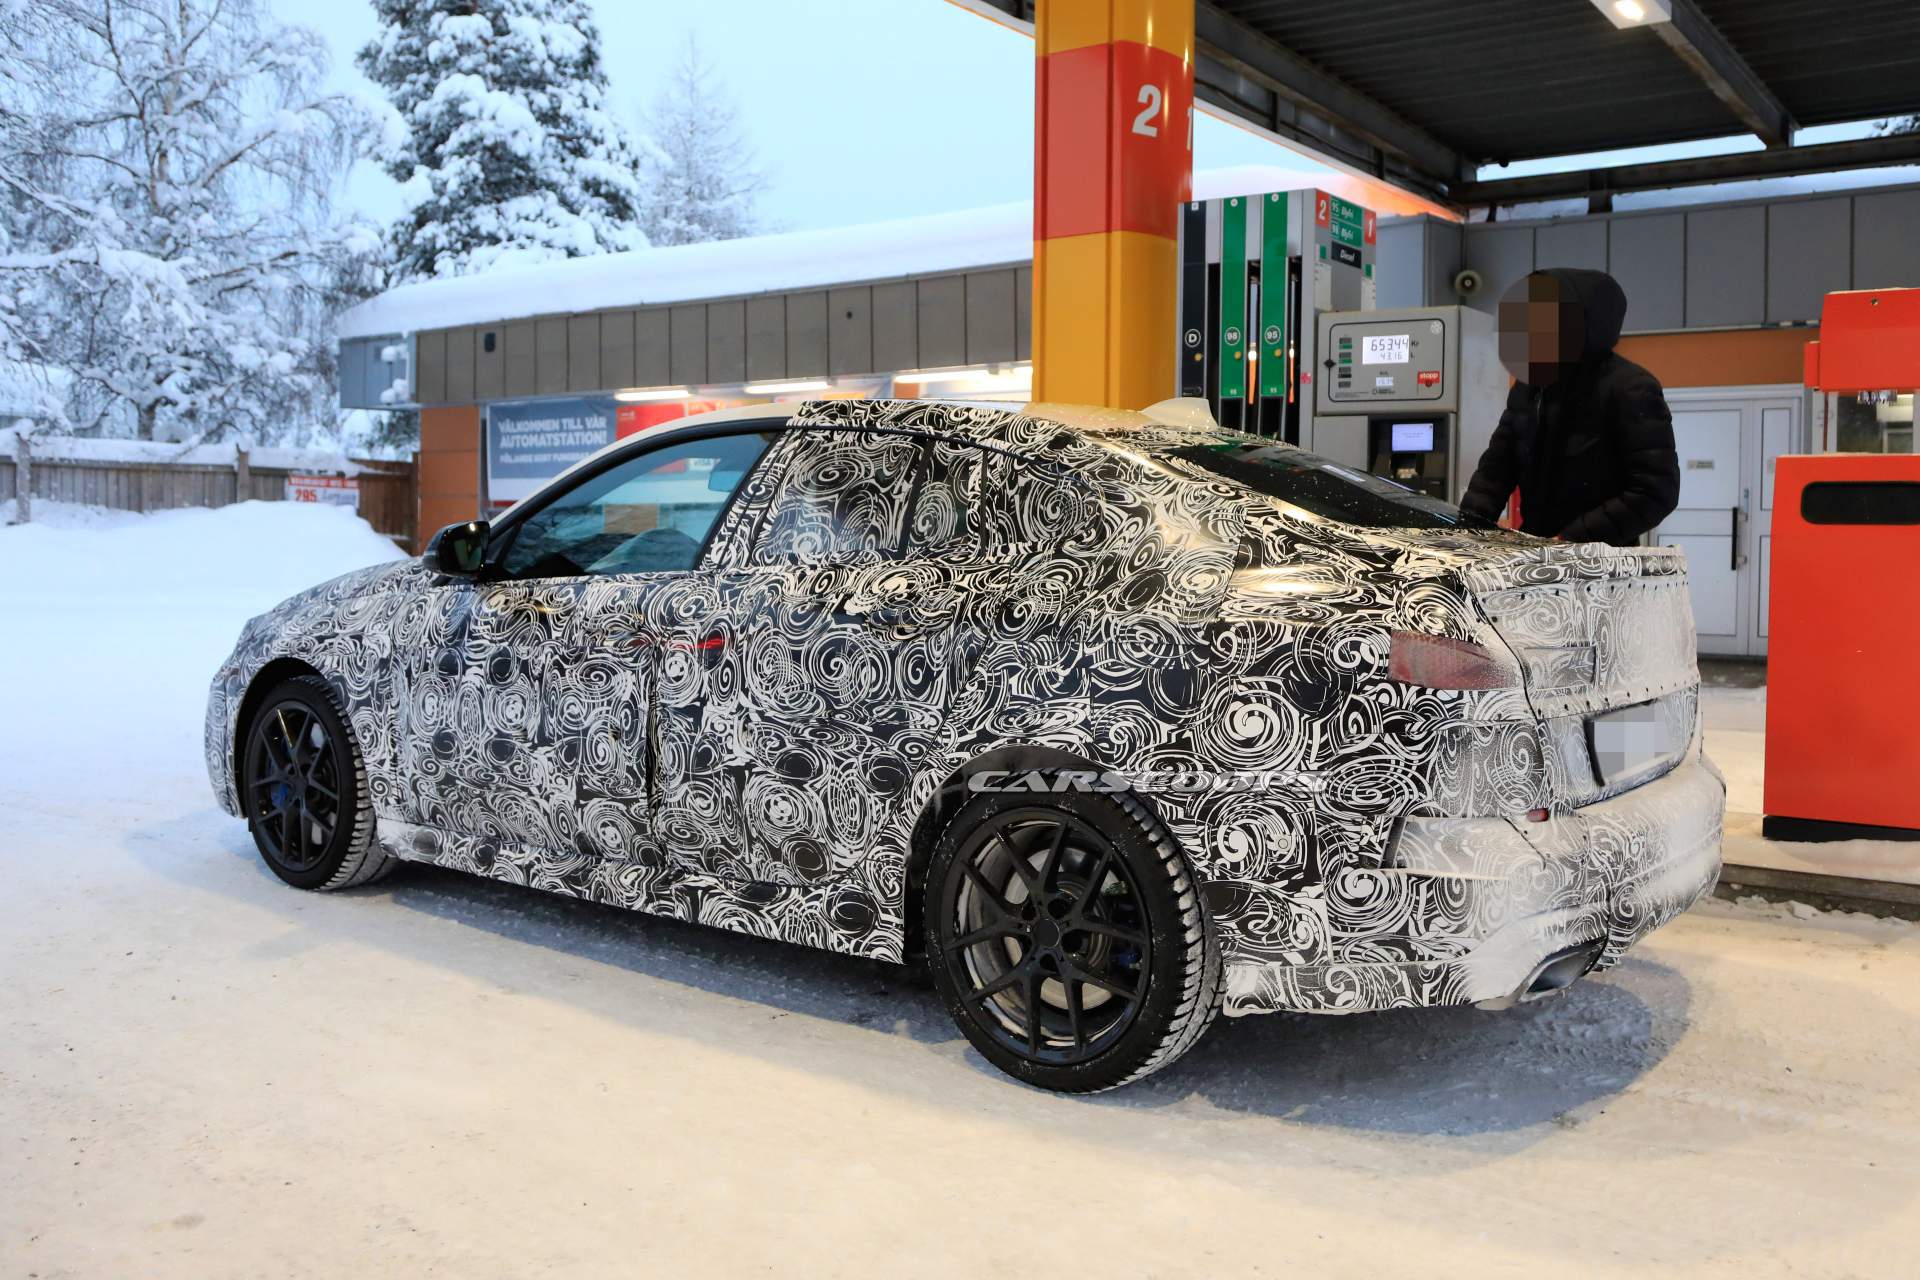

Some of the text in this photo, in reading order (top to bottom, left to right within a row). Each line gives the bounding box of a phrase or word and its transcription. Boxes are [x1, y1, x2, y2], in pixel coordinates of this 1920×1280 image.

[1132, 84, 1162, 138] 2
[1318, 199, 1327, 220] 2
[1368, 218, 1374, 238] 1
[1188, 333, 1198, 344] D
[1266, 330, 1278, 340] 95
[1419, 372, 1438, 380] stopp
[561, 417, 584, 430] TILL
[584, 413, 607, 429] VÅR
[499, 430, 607, 448] AUTOMATSTATION!
